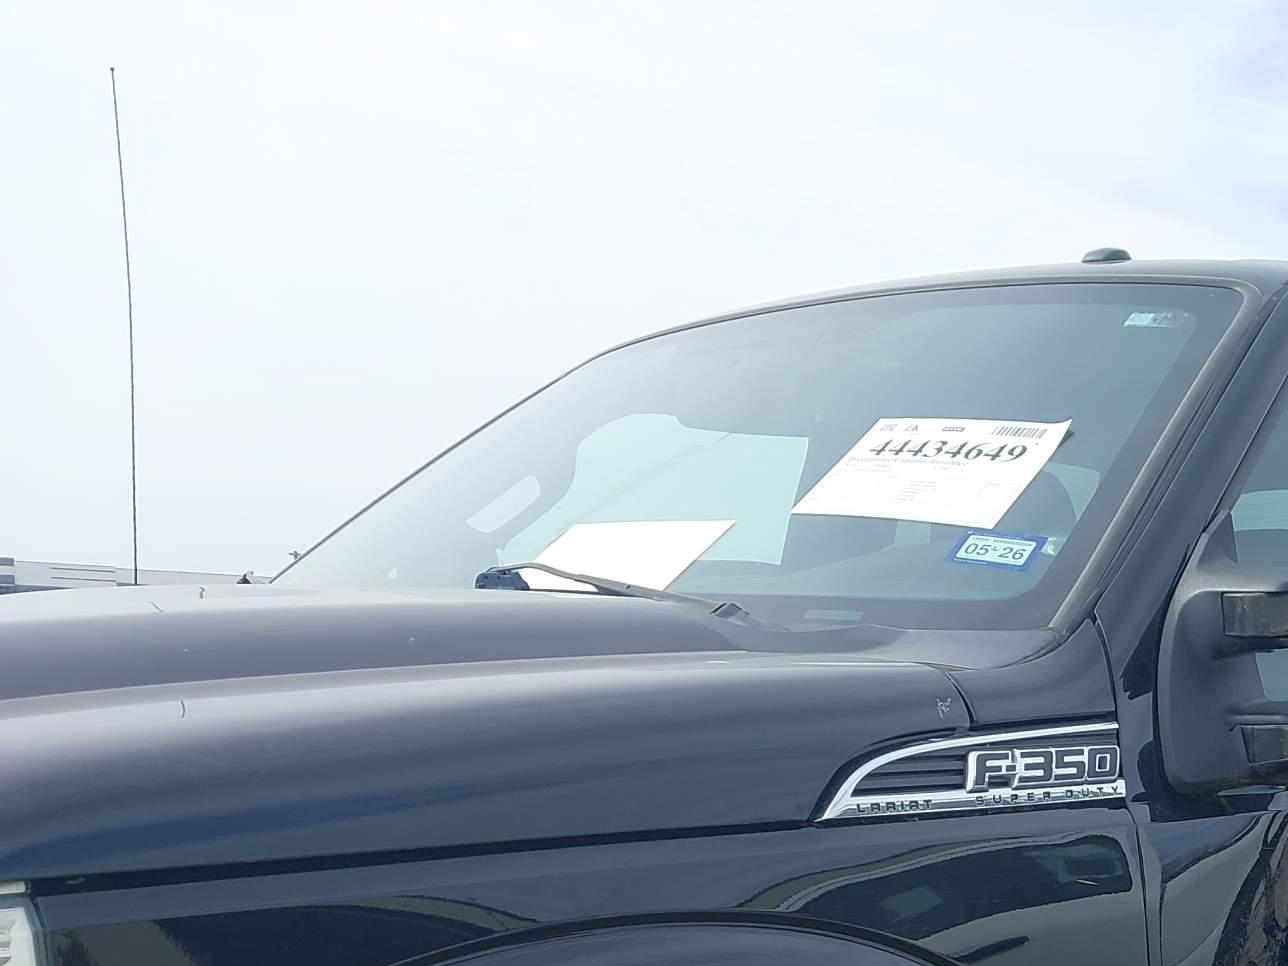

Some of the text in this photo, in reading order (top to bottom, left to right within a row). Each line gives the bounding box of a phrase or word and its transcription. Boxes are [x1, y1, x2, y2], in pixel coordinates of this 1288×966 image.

[869, 439, 1029, 463] 44434649
[964, 543, 1027, 561] 05 26
[967, 746, 1120, 793] F-350
[856, 799, 932, 813] LARIAT
[975, 785, 1119, 806] SUPER DUTY
